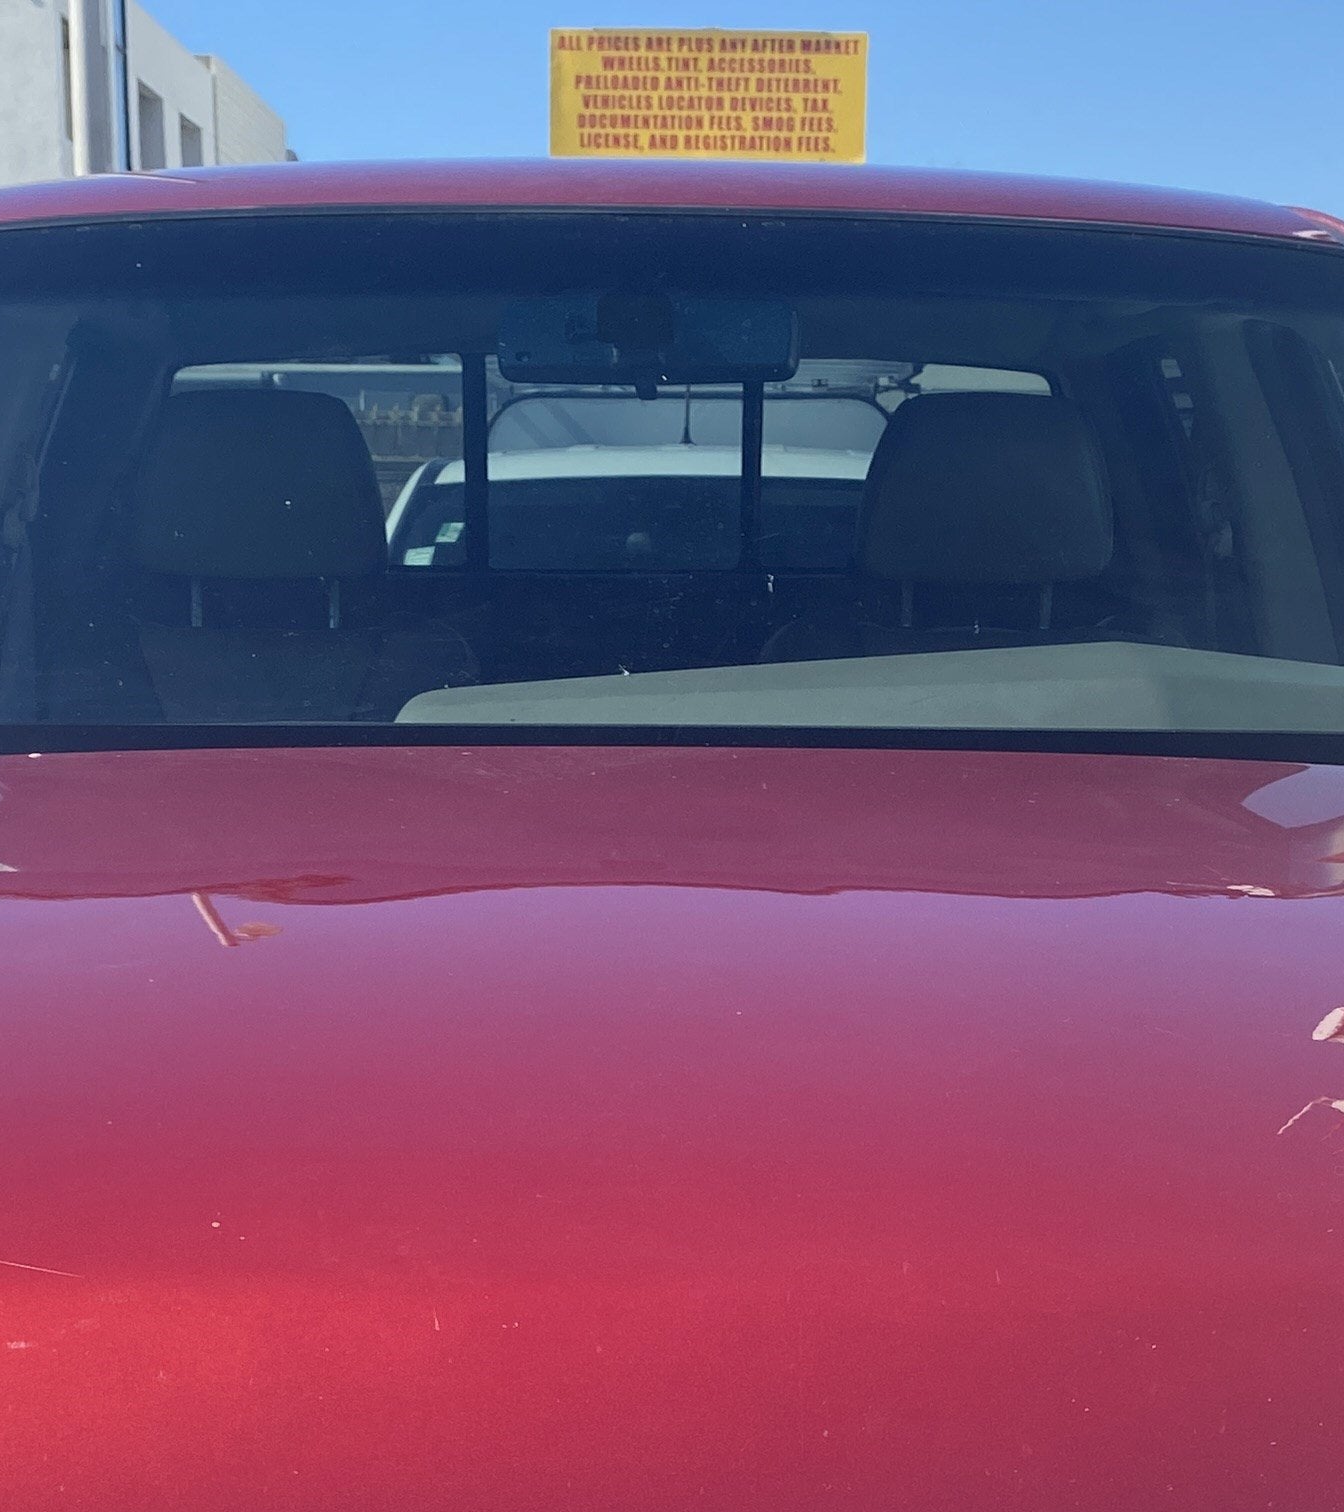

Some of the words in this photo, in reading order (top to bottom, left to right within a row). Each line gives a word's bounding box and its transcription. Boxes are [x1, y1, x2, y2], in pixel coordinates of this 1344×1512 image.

[558, 36, 582, 50] ALL
[587, 36, 641, 51] PRICES
[645, 36, 672, 51] ARE
[678, 37, 713, 52] PLUS
[719, 38, 747, 52] ANY
[751, 38, 795, 53] AFTER
[800, 38, 859, 54] MARKET
[575, 75, 660, 90] PRELOADED
[664, 76, 750, 92] ANTI-THEFT
[582, 94, 653, 110] VEHICLES
[657, 95, 724, 111] LOCATOR
[577, 113, 704, 130] DOCUMENTATION
[752, 116, 795, 132] SMOG
[648, 135, 678, 150] AND
[683, 135, 792, 151] REGISTRATION
